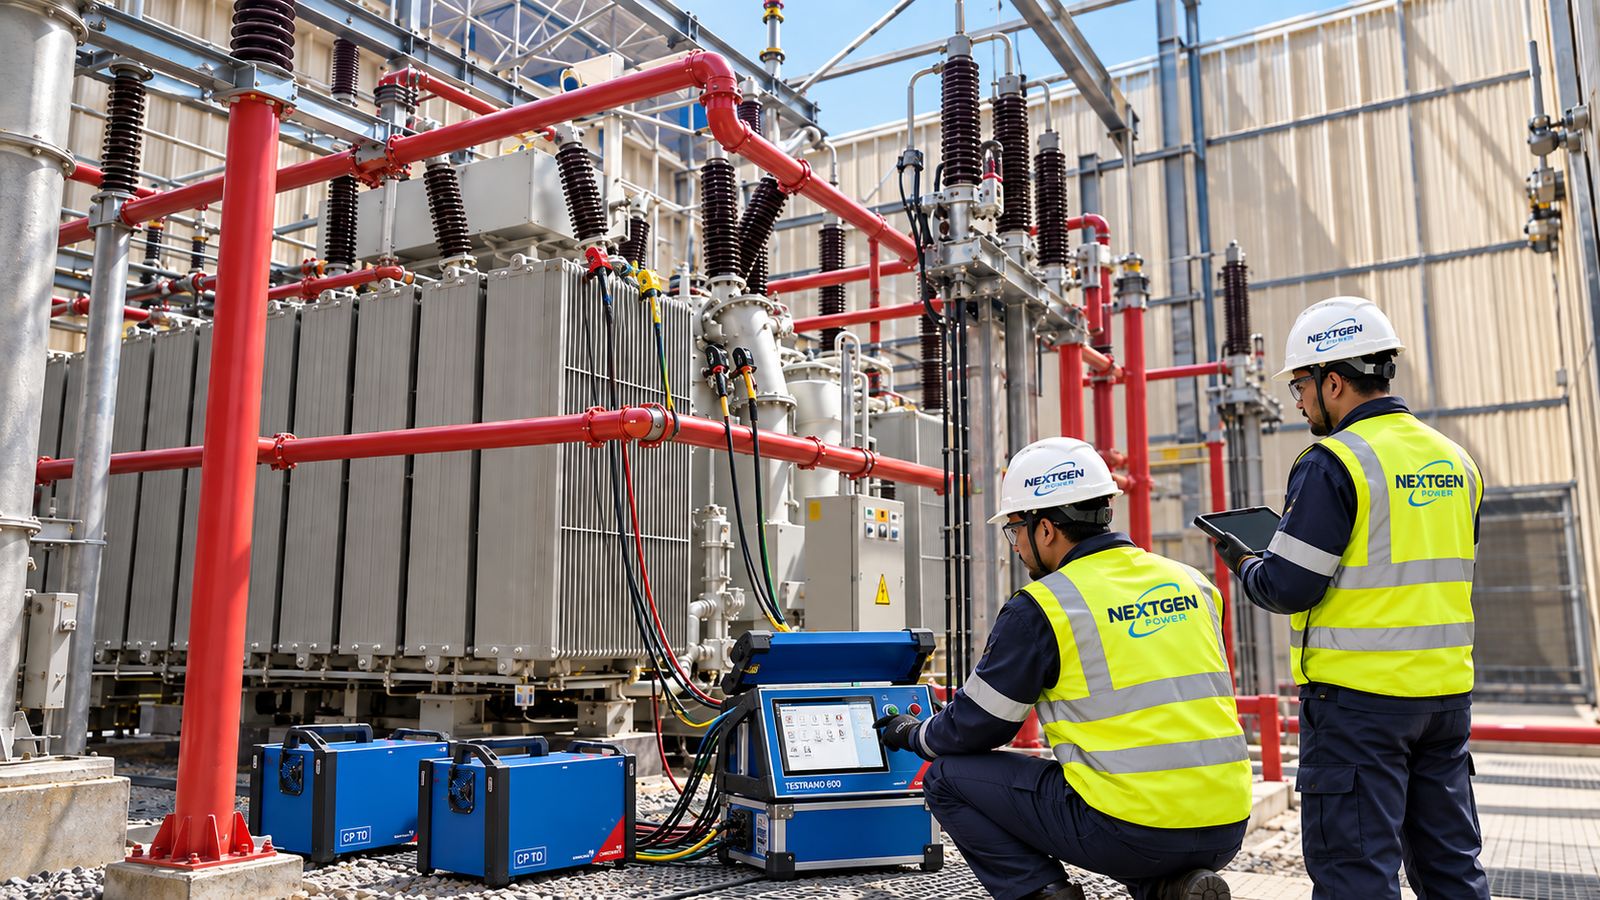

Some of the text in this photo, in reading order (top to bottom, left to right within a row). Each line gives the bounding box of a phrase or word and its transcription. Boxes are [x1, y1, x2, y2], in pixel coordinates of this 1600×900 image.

[1307, 324, 1363, 344] NEXTGEN
[1024, 468, 1084, 488] NEXTGEN
[1395, 474, 1464, 488] NEXTGEN
[1107, 595, 1199, 623] NEXTGEN
[1145, 613, 1187, 626] POWER
[343, 831, 355, 843] CP
[517, 853, 530, 865] CP
